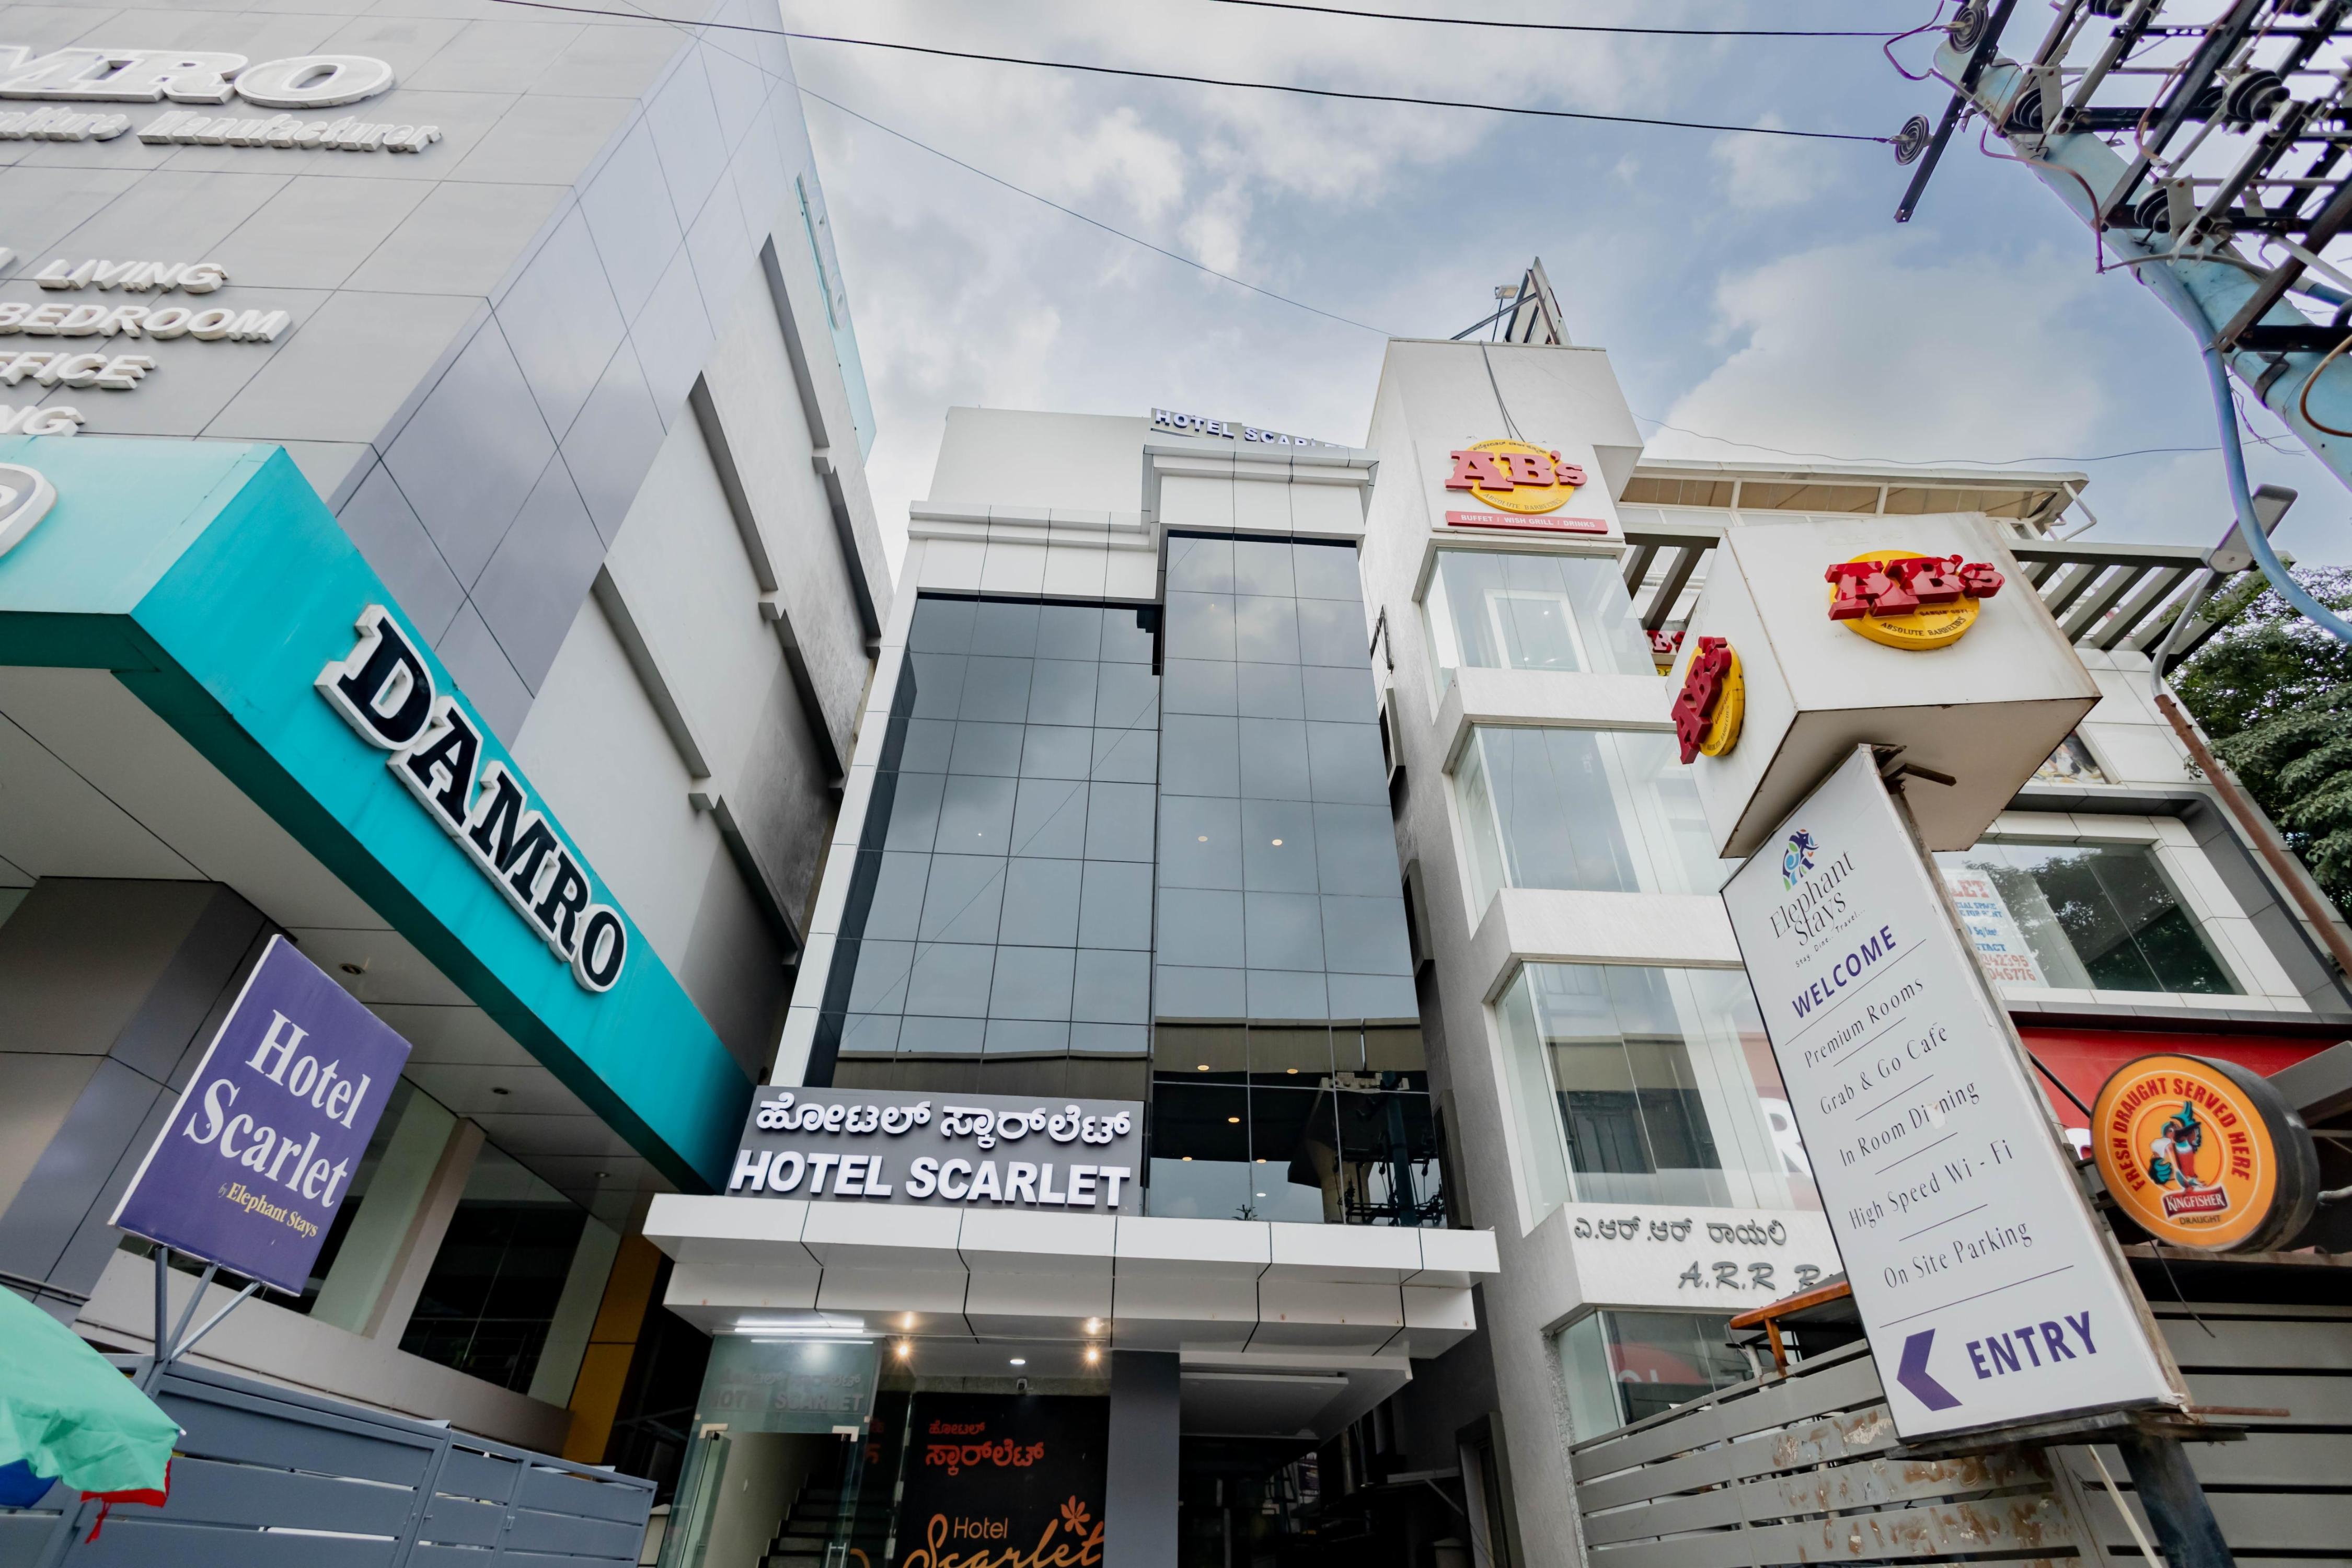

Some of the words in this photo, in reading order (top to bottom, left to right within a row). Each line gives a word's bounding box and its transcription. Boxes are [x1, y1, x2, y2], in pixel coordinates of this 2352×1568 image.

[137, 111, 442, 153] Manufacturer
[34, 259, 228, 294] LIVING
[0, 302, 291, 341] BEDROOM
[1155, 409, 1235, 439] HOTEL
[1445, 450, 1588, 492] AB's
[1483, 493, 1521, 510] ABSOLUTE
[1825, 554, 2005, 621] AB's
[1881, 622, 1924, 636] ABSOLUTE
[1927, 616, 1966, 636] BARBECUES
[314, 603, 628, 993] DAMRO
[1769, 849, 1855, 940] Elephant
[1794, 892, 1846, 946] Stays
[1792, 925, 1896, 1019] WELCOME
[1804, 1021, 1864, 1069] Premium
[1866, 978, 1923, 1024] Rooms
[245, 1009, 371, 1129] Hotel
[1820, 1083, 1854, 1115] Grab
[1860, 1071, 1873, 1090] &
[1877, 1057, 1901, 1078] Go
[1839, 1148, 1855, 1167] In
[1857, 1122, 1906, 1157] Room
[1908, 1082, 1979, 1129] Dining
[2113, 1077, 2167, 1134] DRAUGHT
[2173, 1077, 2237, 1128] SERVED
[183, 1078, 350, 1208] Scarlet
[2113, 1136, 2146, 1192] FRESH
[2228, 1131, 2251, 1181] HERE
[729, 1149, 893, 1198] HOTEL
[906, 1156, 1131, 1209] SCARLET
[1849, 1199, 1884, 1230] High
[1887, 1172, 1941, 1213] Speed
[2165, 1193, 2226, 1211] KINGFISHER
[226, 1182, 287, 1223] Elephant
[287, 1211, 318, 1238] Stays
[2179, 1214, 2221, 1225] DRAUGHT
[1883, 1265, 1909, 1289] On
[1913, 1249, 1948, 1279] Site
[1953, 1222, 2033, 1264] Parking
[1965, 1310, 2097, 1380] ENTRY
[953, 1517, 1008, 1539] Hotel
